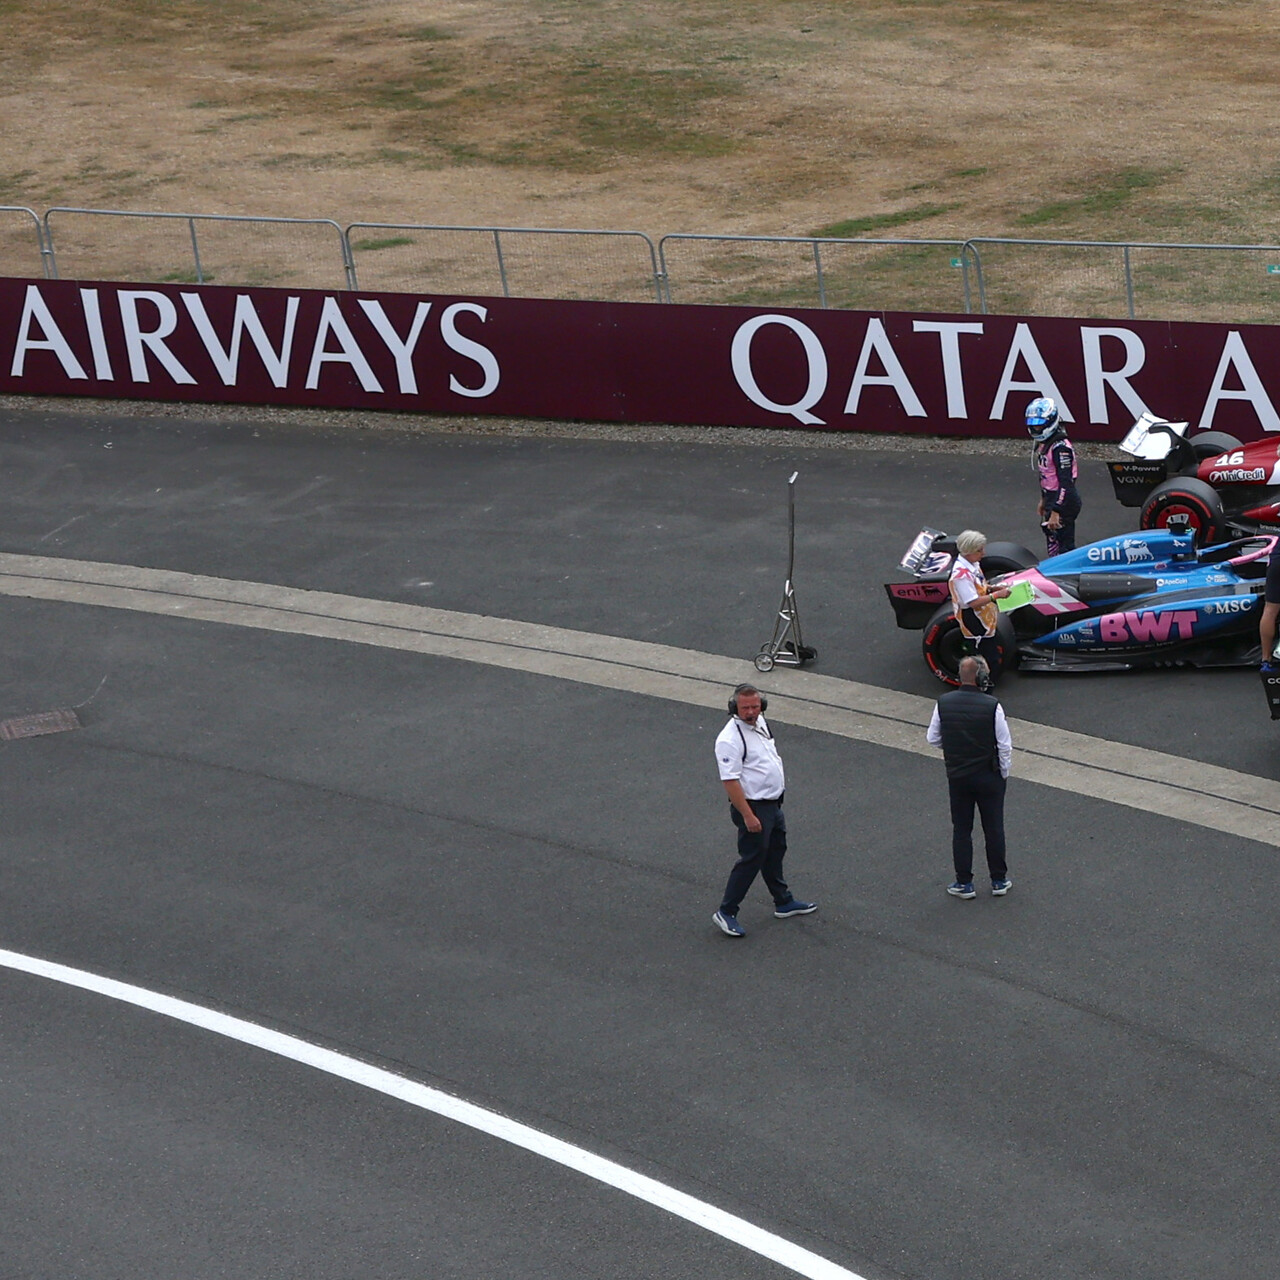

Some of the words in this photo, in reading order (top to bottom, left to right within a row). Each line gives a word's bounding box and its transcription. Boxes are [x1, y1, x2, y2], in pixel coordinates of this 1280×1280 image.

[10, 284, 501, 398] AIRWAYS
[731, 314, 1153, 425] QATAR
[1214, 451, 1244, 467] 16
[1221, 469, 1265, 482] UniCredit
[1087, 542, 1121, 563] eni
[897, 586, 921, 598] eni
[1216, 599, 1252, 614] MSC
[1100, 611, 1198, 643] BWT
